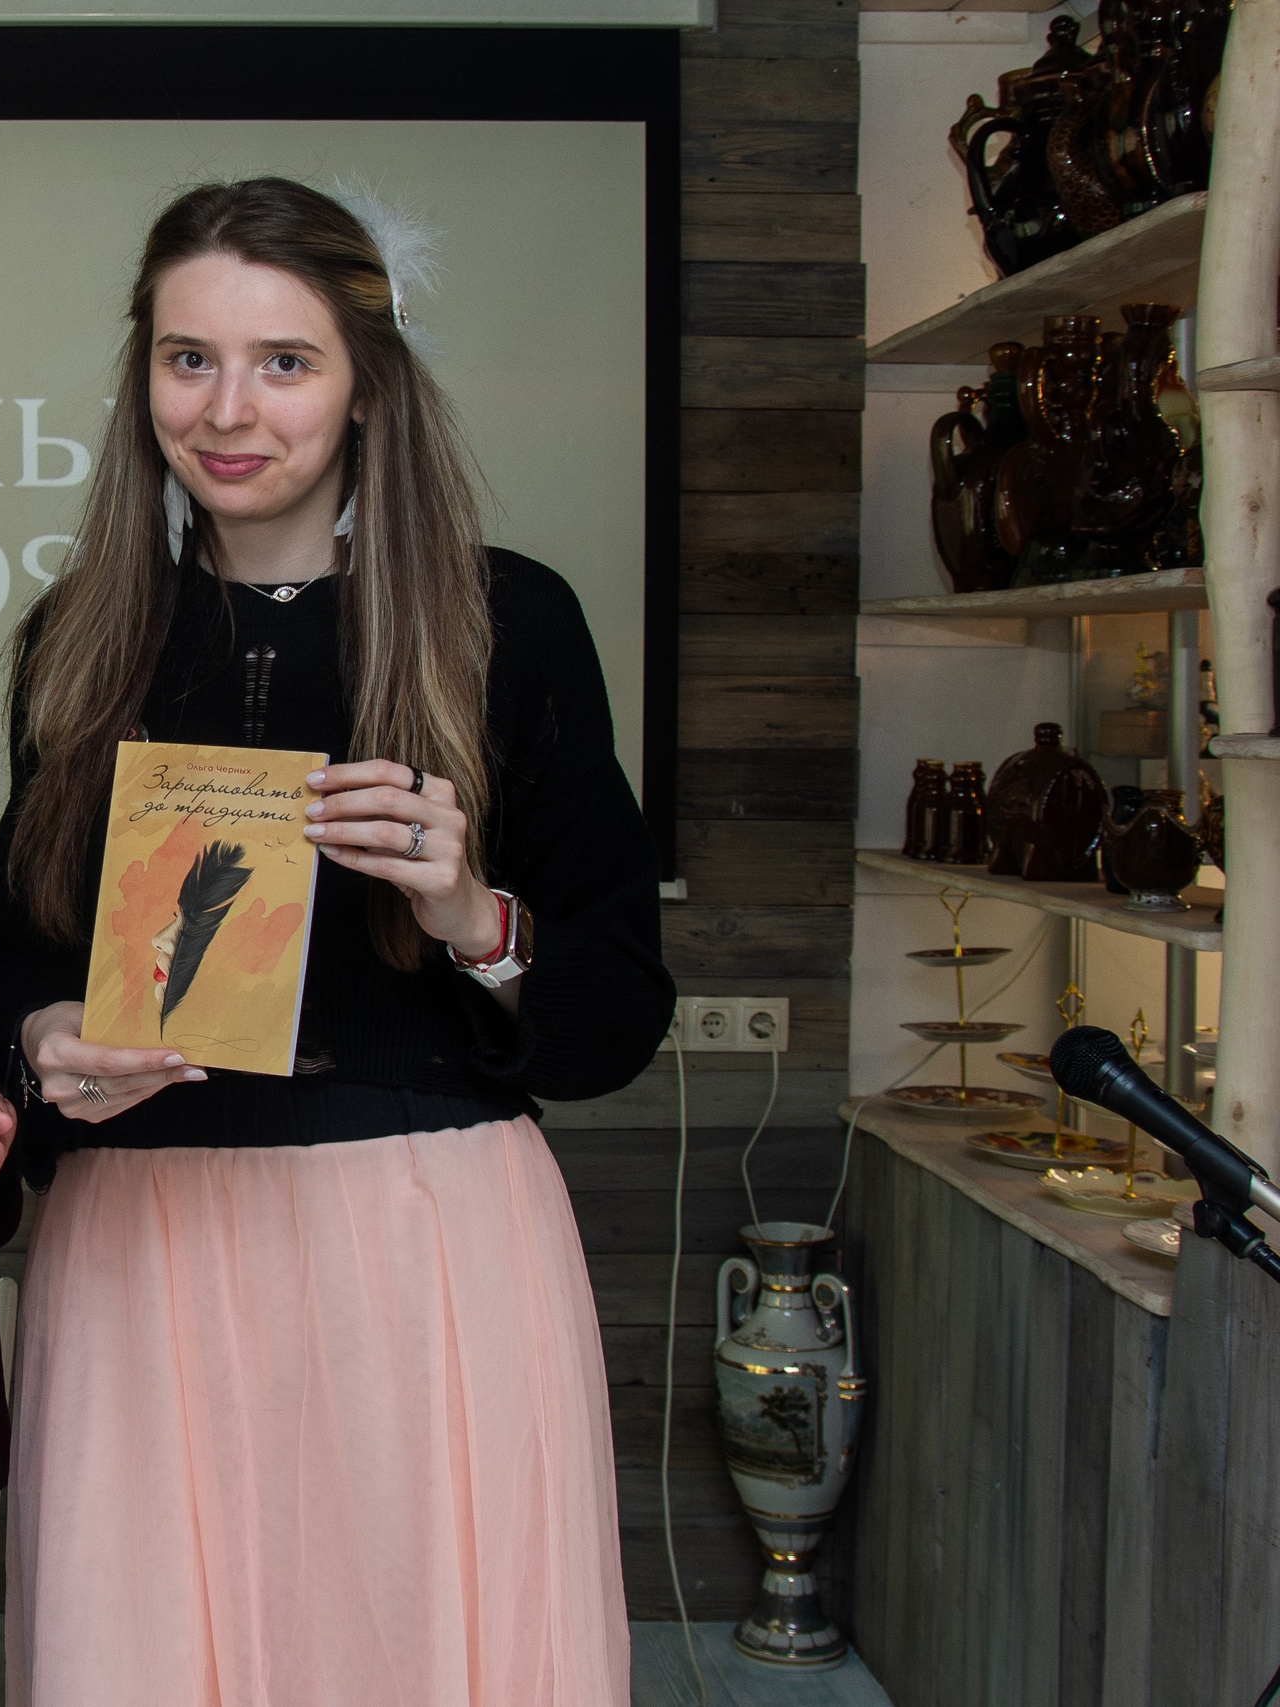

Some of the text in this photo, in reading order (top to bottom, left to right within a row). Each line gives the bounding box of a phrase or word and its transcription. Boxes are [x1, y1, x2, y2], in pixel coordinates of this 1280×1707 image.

[186, 762, 252, 776] Ольга Черных
[142, 764, 304, 804] Зарифмовать
[129, 800, 297, 828] до тридцати
